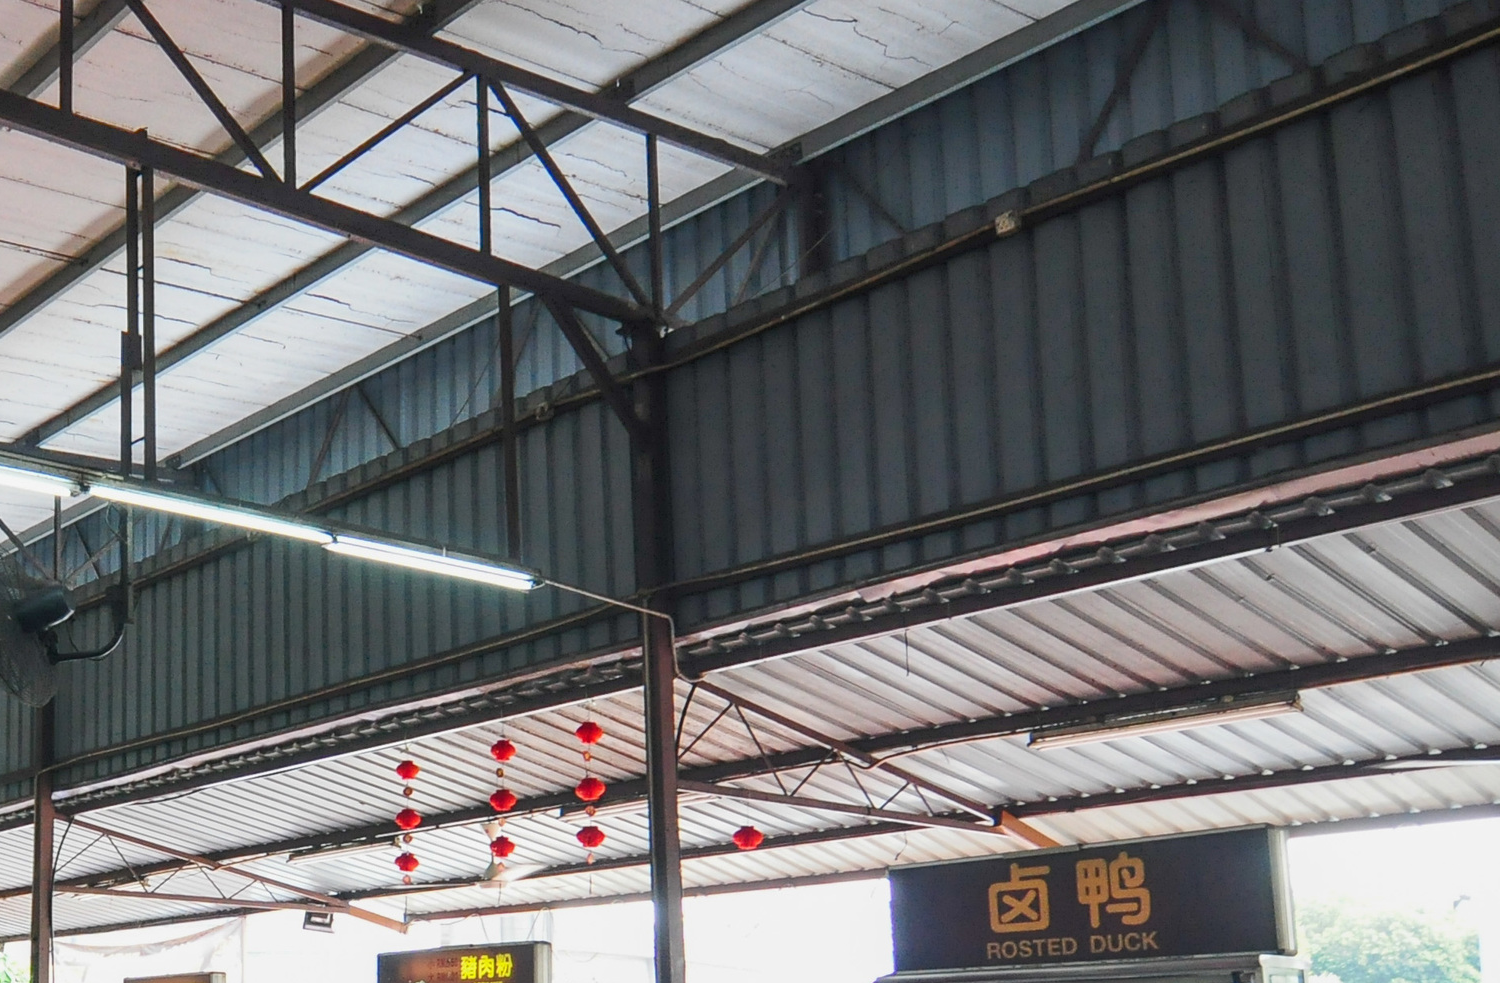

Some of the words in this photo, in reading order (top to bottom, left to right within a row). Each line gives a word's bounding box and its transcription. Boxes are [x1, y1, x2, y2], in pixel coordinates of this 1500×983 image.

[988, 851, 1151, 934] 卤鸭
[986, 937, 1078, 960] ROSTED
[1089, 931, 1159, 954] DUCK
[460, 953, 514, 980] 豬肉粉
